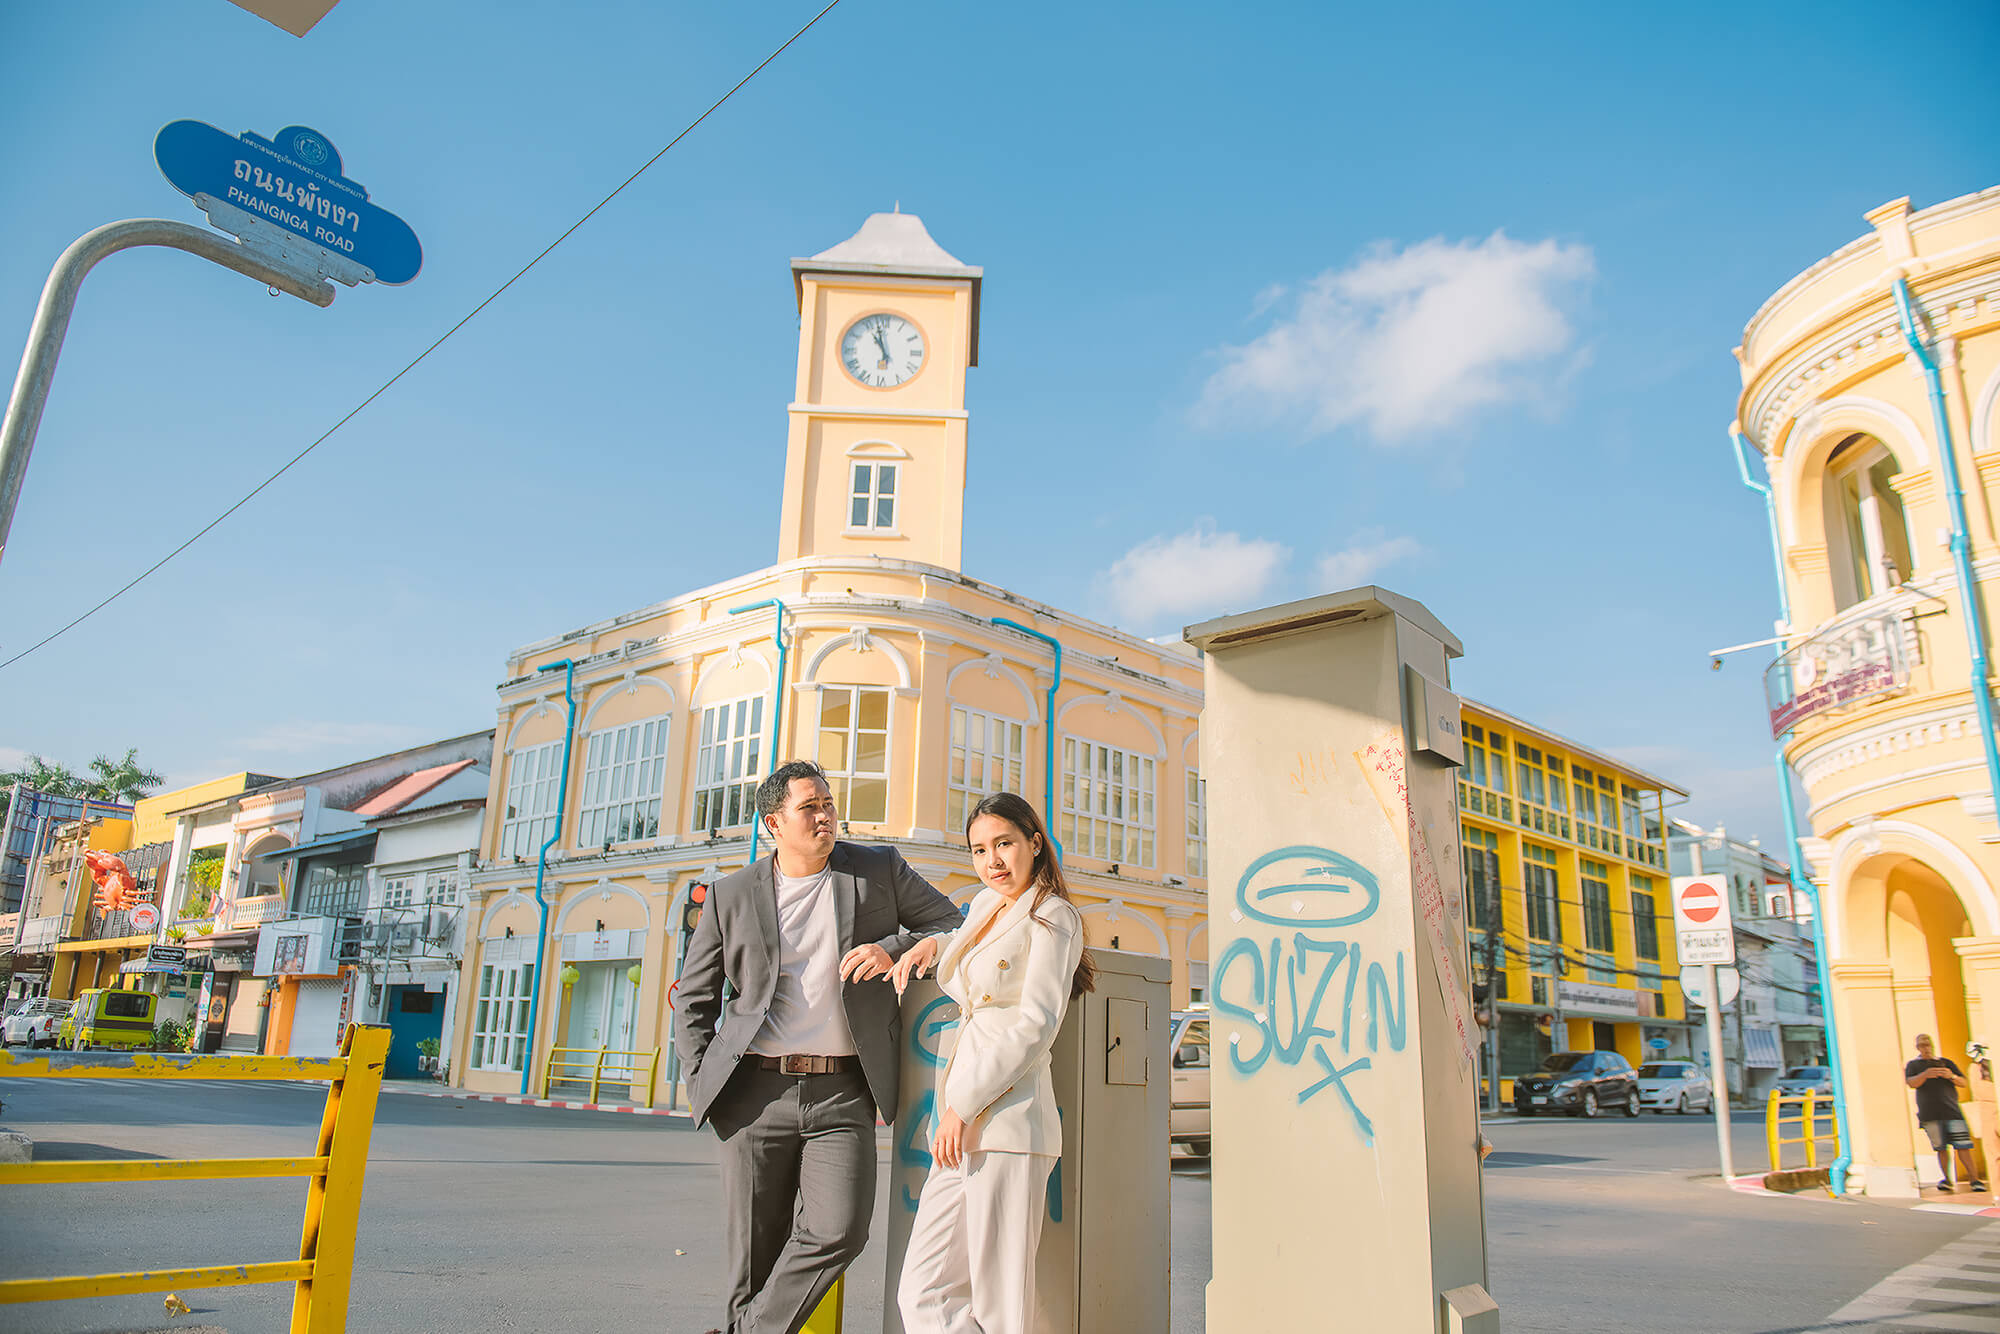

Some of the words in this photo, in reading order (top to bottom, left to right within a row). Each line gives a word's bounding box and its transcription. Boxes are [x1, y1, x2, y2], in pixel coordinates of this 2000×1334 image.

[233, 158, 360, 232] ถนนพังงา
[292, 161, 314, 175] PHUKET
[314, 172, 328, 181] CITY
[327, 177, 365, 200] MUNICIPALITY
[227, 186, 309, 233] PHANGNGA
[315, 226, 355, 253] ROAD
[1211, 932, 1407, 1075] SUZIN
